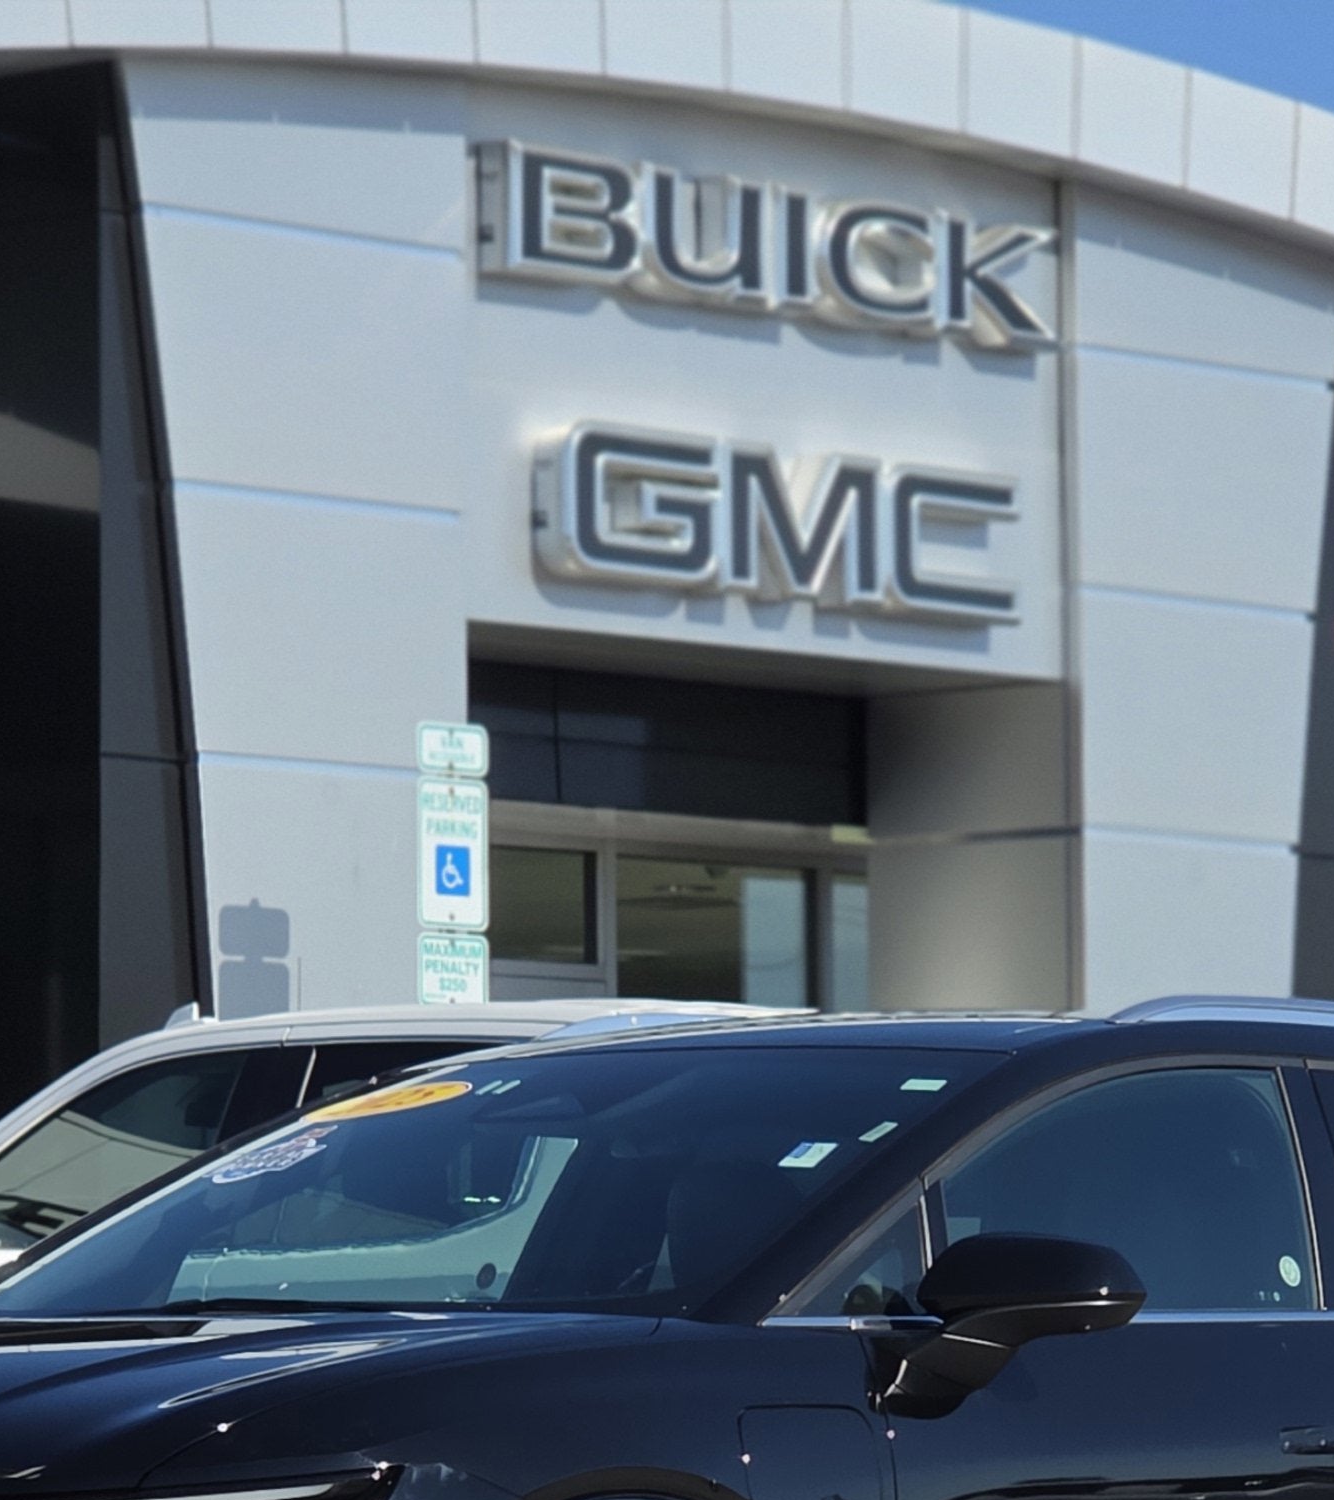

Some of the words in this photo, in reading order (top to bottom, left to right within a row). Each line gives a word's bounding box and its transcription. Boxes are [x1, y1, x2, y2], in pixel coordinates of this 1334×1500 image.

[482, 138, 1061, 352] BUICK
[539, 418, 1021, 626] GMC
[420, 793, 483, 816] RESERVED
[425, 817, 478, 840] PARKING
[422, 942, 483, 959] MAXIMUM
[425, 959, 480, 977] PENALTY
